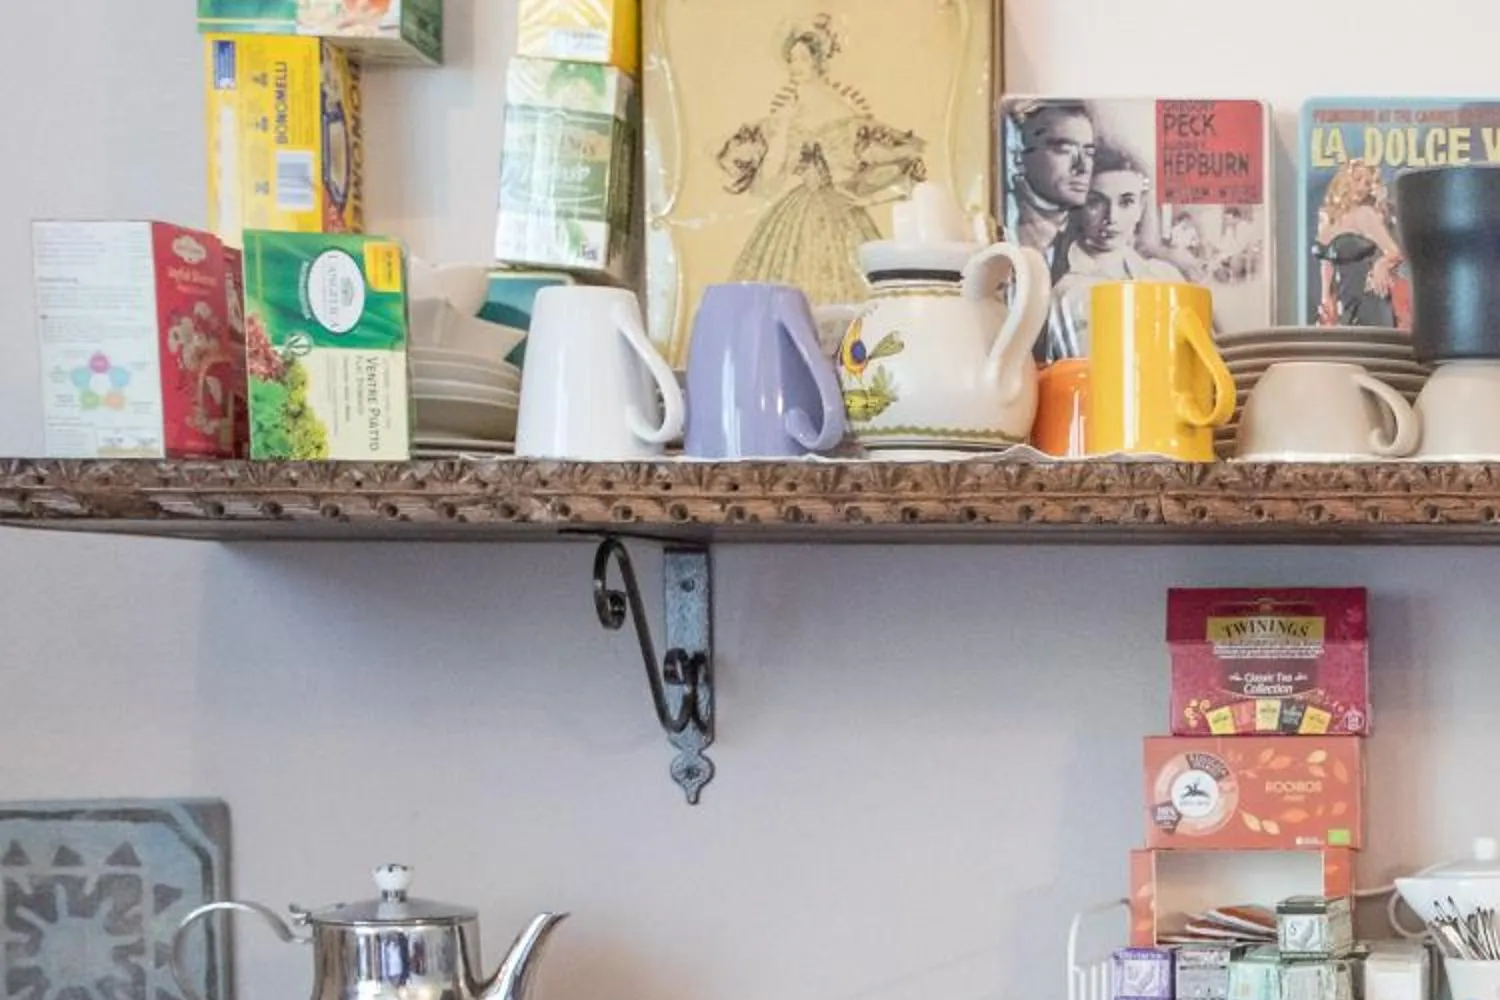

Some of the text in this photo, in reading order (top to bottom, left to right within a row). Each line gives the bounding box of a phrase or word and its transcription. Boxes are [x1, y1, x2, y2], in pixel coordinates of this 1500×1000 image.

[1163, 113, 1216, 137] PECK
[1310, 126, 1347, 167] LA
[1363, 126, 1471, 168] DOLCE
[1163, 151, 1249, 178] HEPBURN
[365, 355, 379, 403] VENTRE
[1221, 618, 1309, 639] TWININGS
[1243, 684, 1293, 695] Collection
